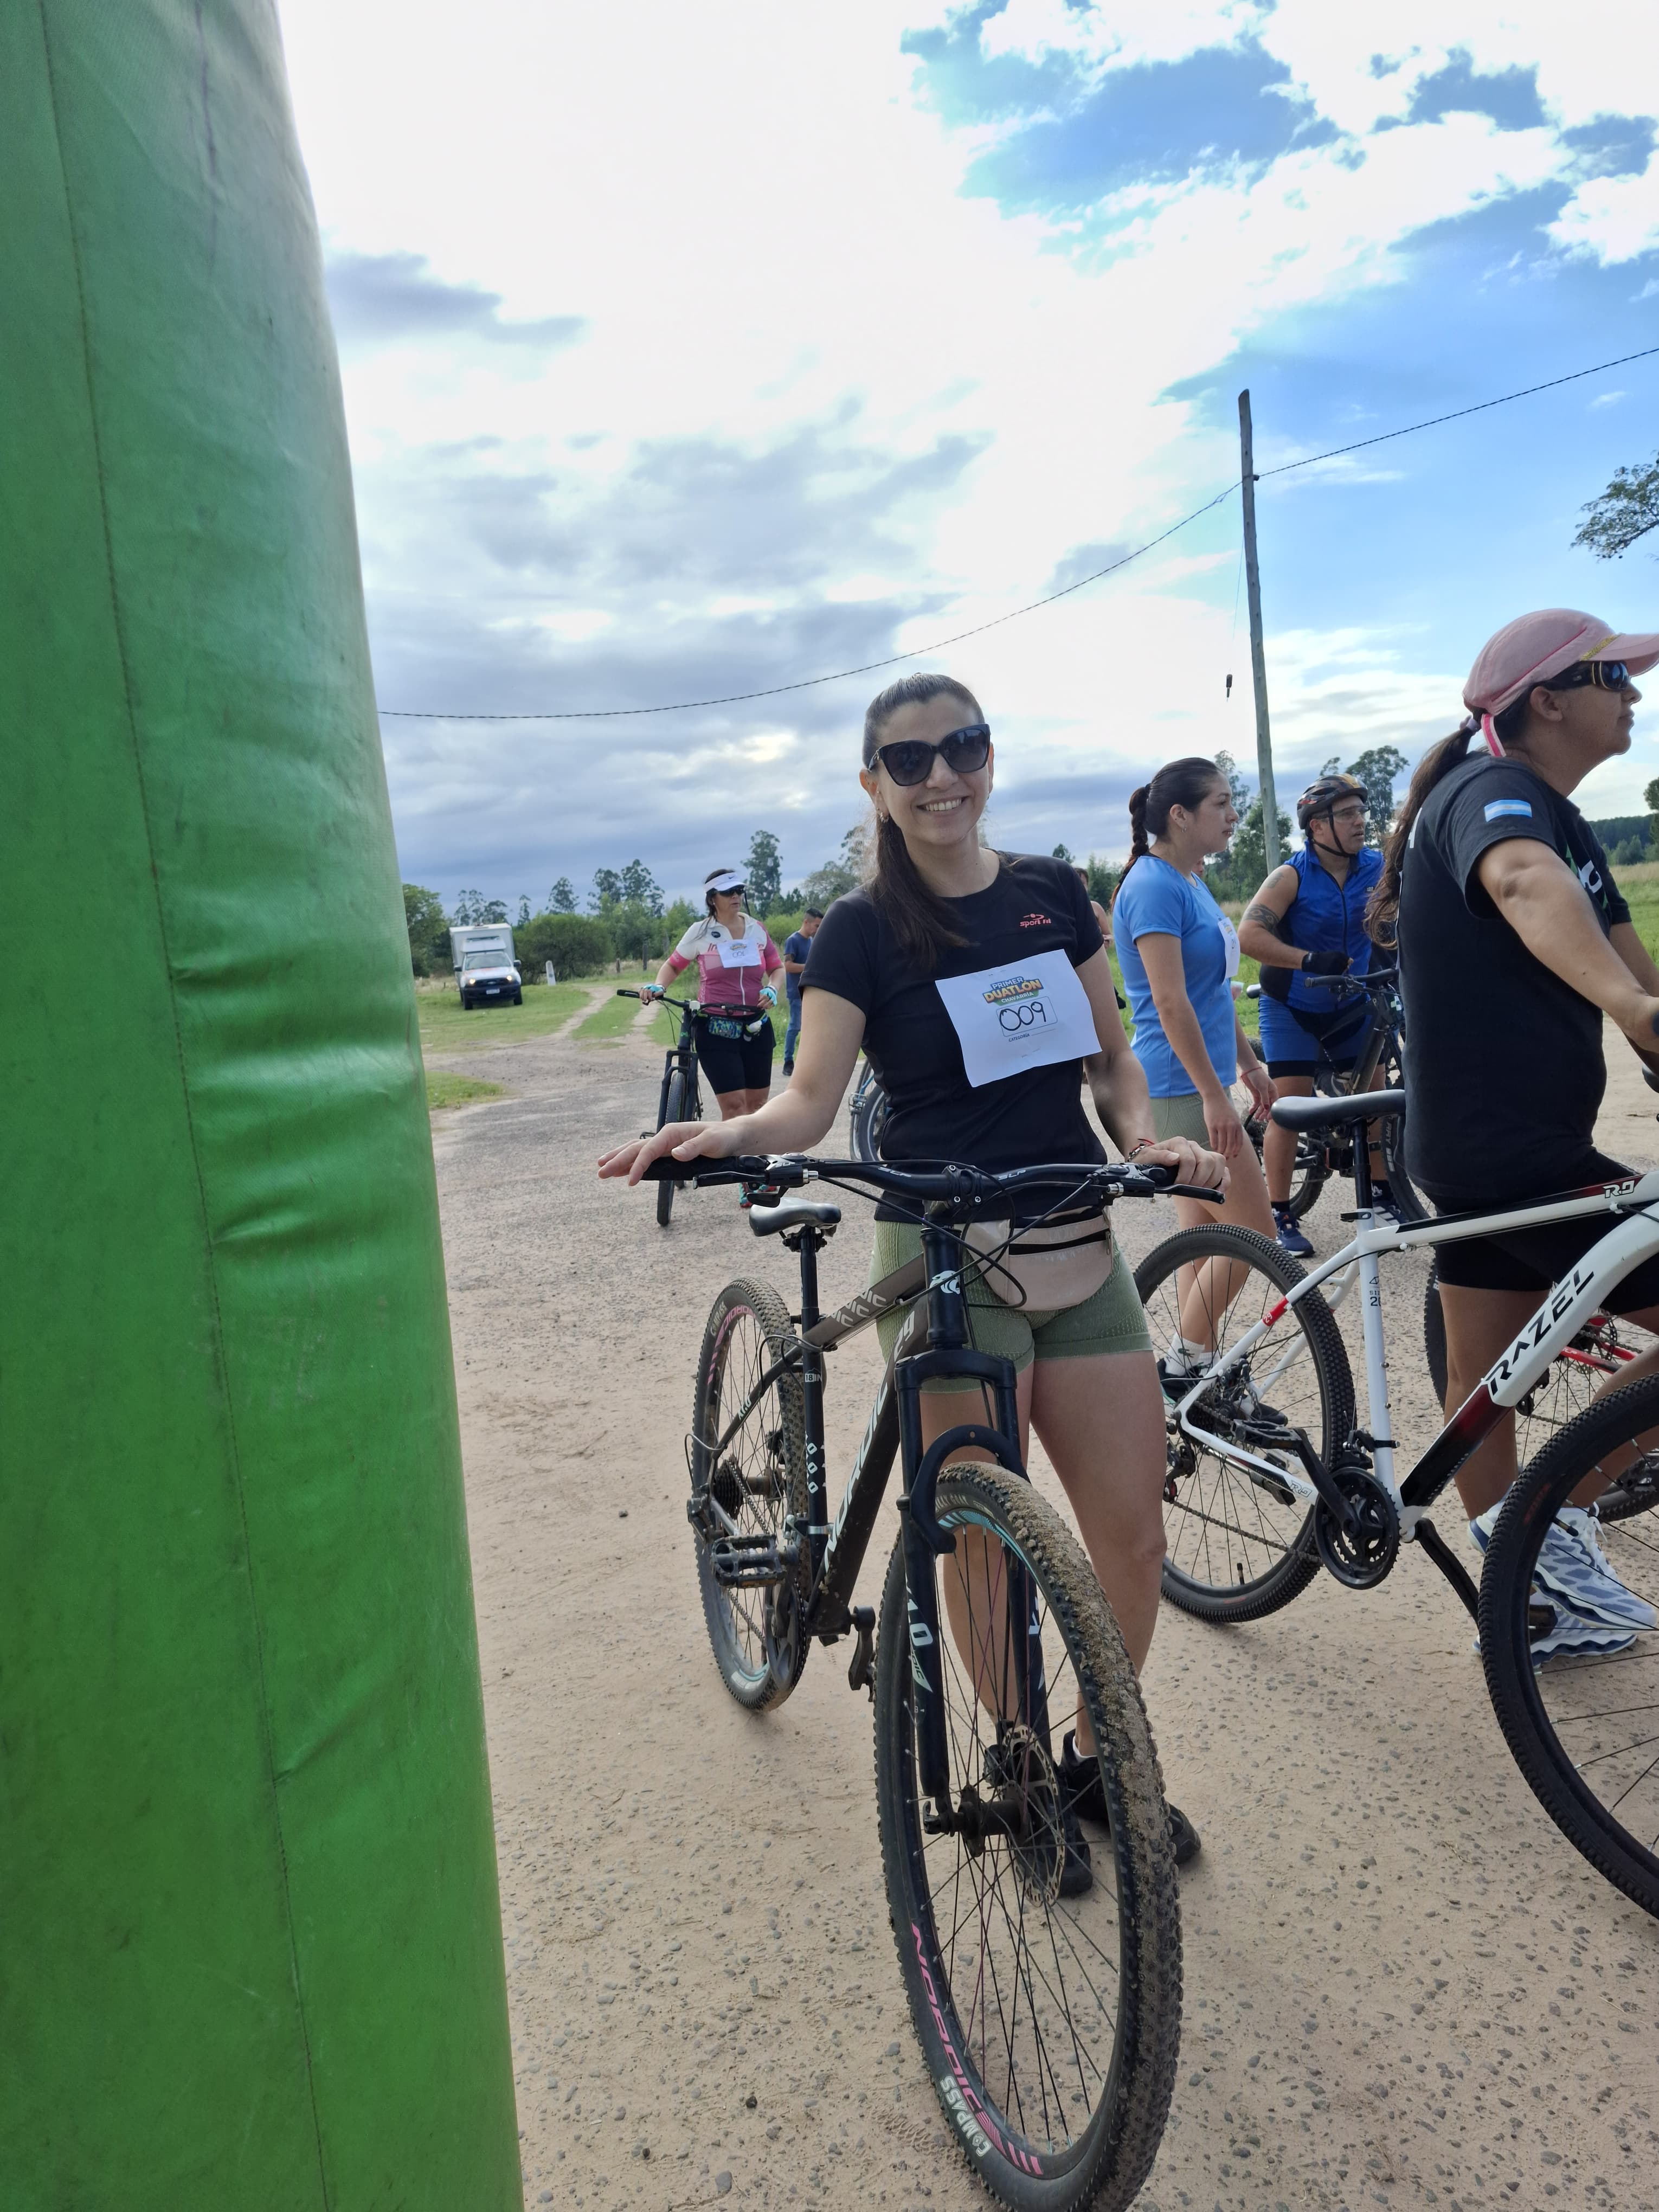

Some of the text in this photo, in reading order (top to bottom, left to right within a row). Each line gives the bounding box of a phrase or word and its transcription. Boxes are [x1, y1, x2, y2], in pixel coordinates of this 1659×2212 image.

[1020, 919, 1041, 928] sport
[983, 979, 1042, 1002] DUATLÓN
[992, 977, 1024, 989] PRIMER
[1001, 992, 1034, 1003] CHAVARRÍA
[999, 1001, 1046, 1031] 009
[1008, 1033, 1030, 1042] CATEGORÍA
[998, 1169, 1026, 1180] SLP
[1264, 1312, 1272, 1323] 29
[1487, 1269, 1594, 1396] RAZEL
[825, 1380, 888, 1573] NORDIC
[911, 1921, 982, 2114] NORDIC
[940, 2075, 993, 2157] COMPASS
